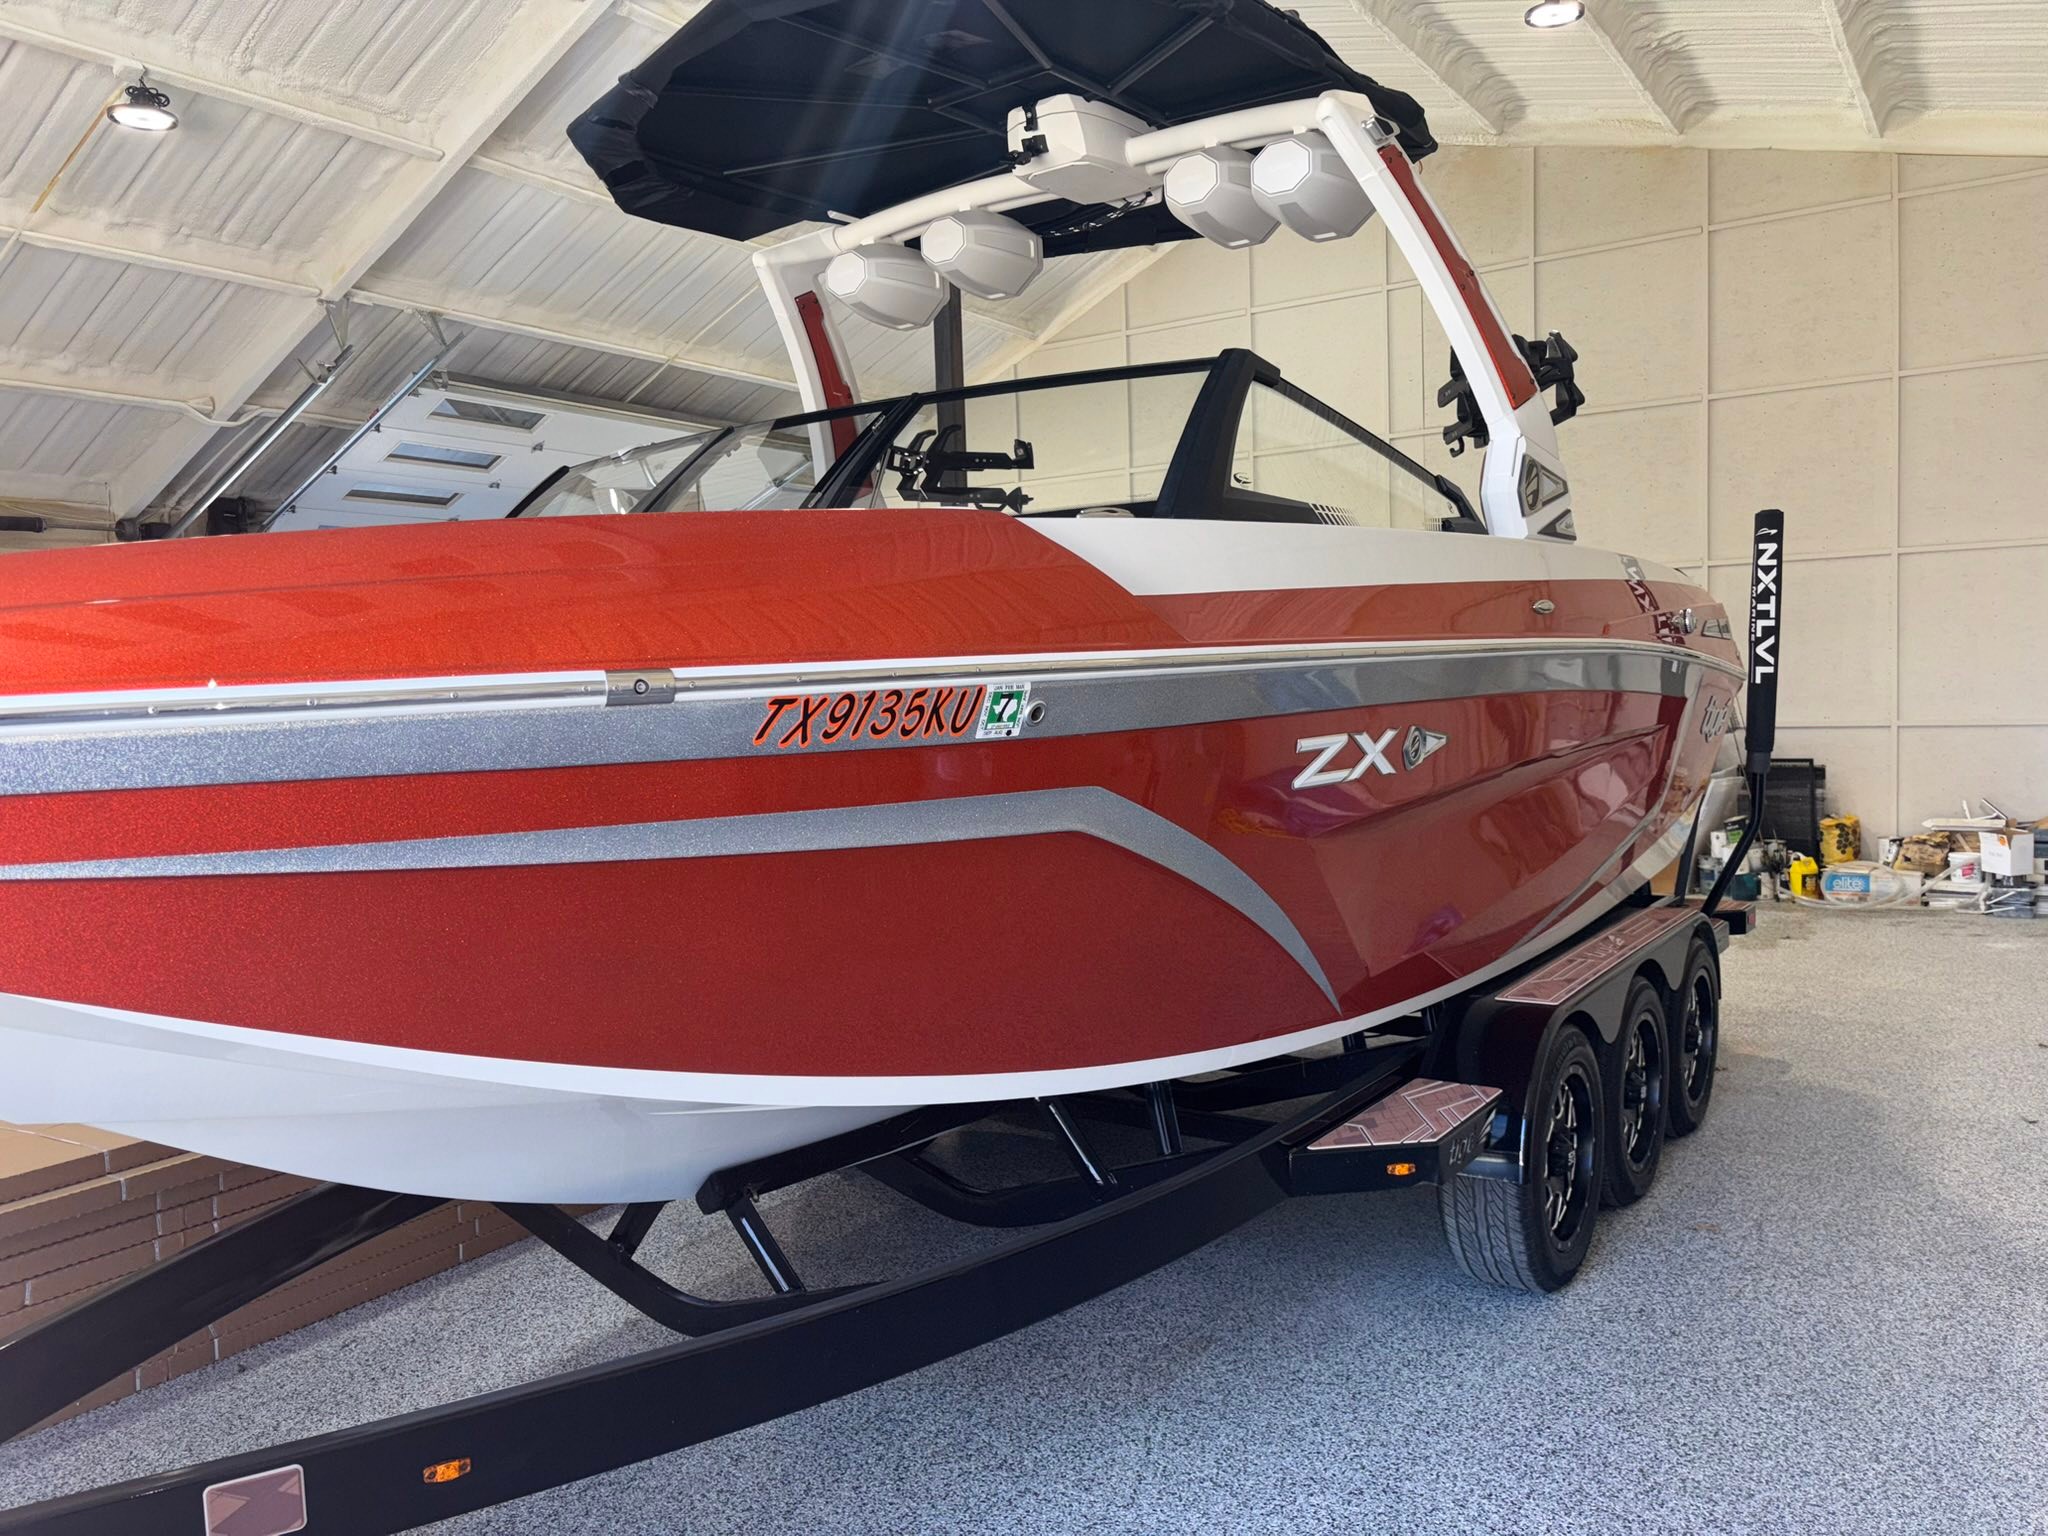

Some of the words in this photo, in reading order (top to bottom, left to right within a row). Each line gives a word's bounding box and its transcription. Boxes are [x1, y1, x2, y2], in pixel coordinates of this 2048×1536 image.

[1755, 542, 1778, 684] NXTLVL
[753, 685, 986, 747] TX9135KU
[996, 693, 1014, 722] 7
[1292, 727, 1400, 791] ZX
